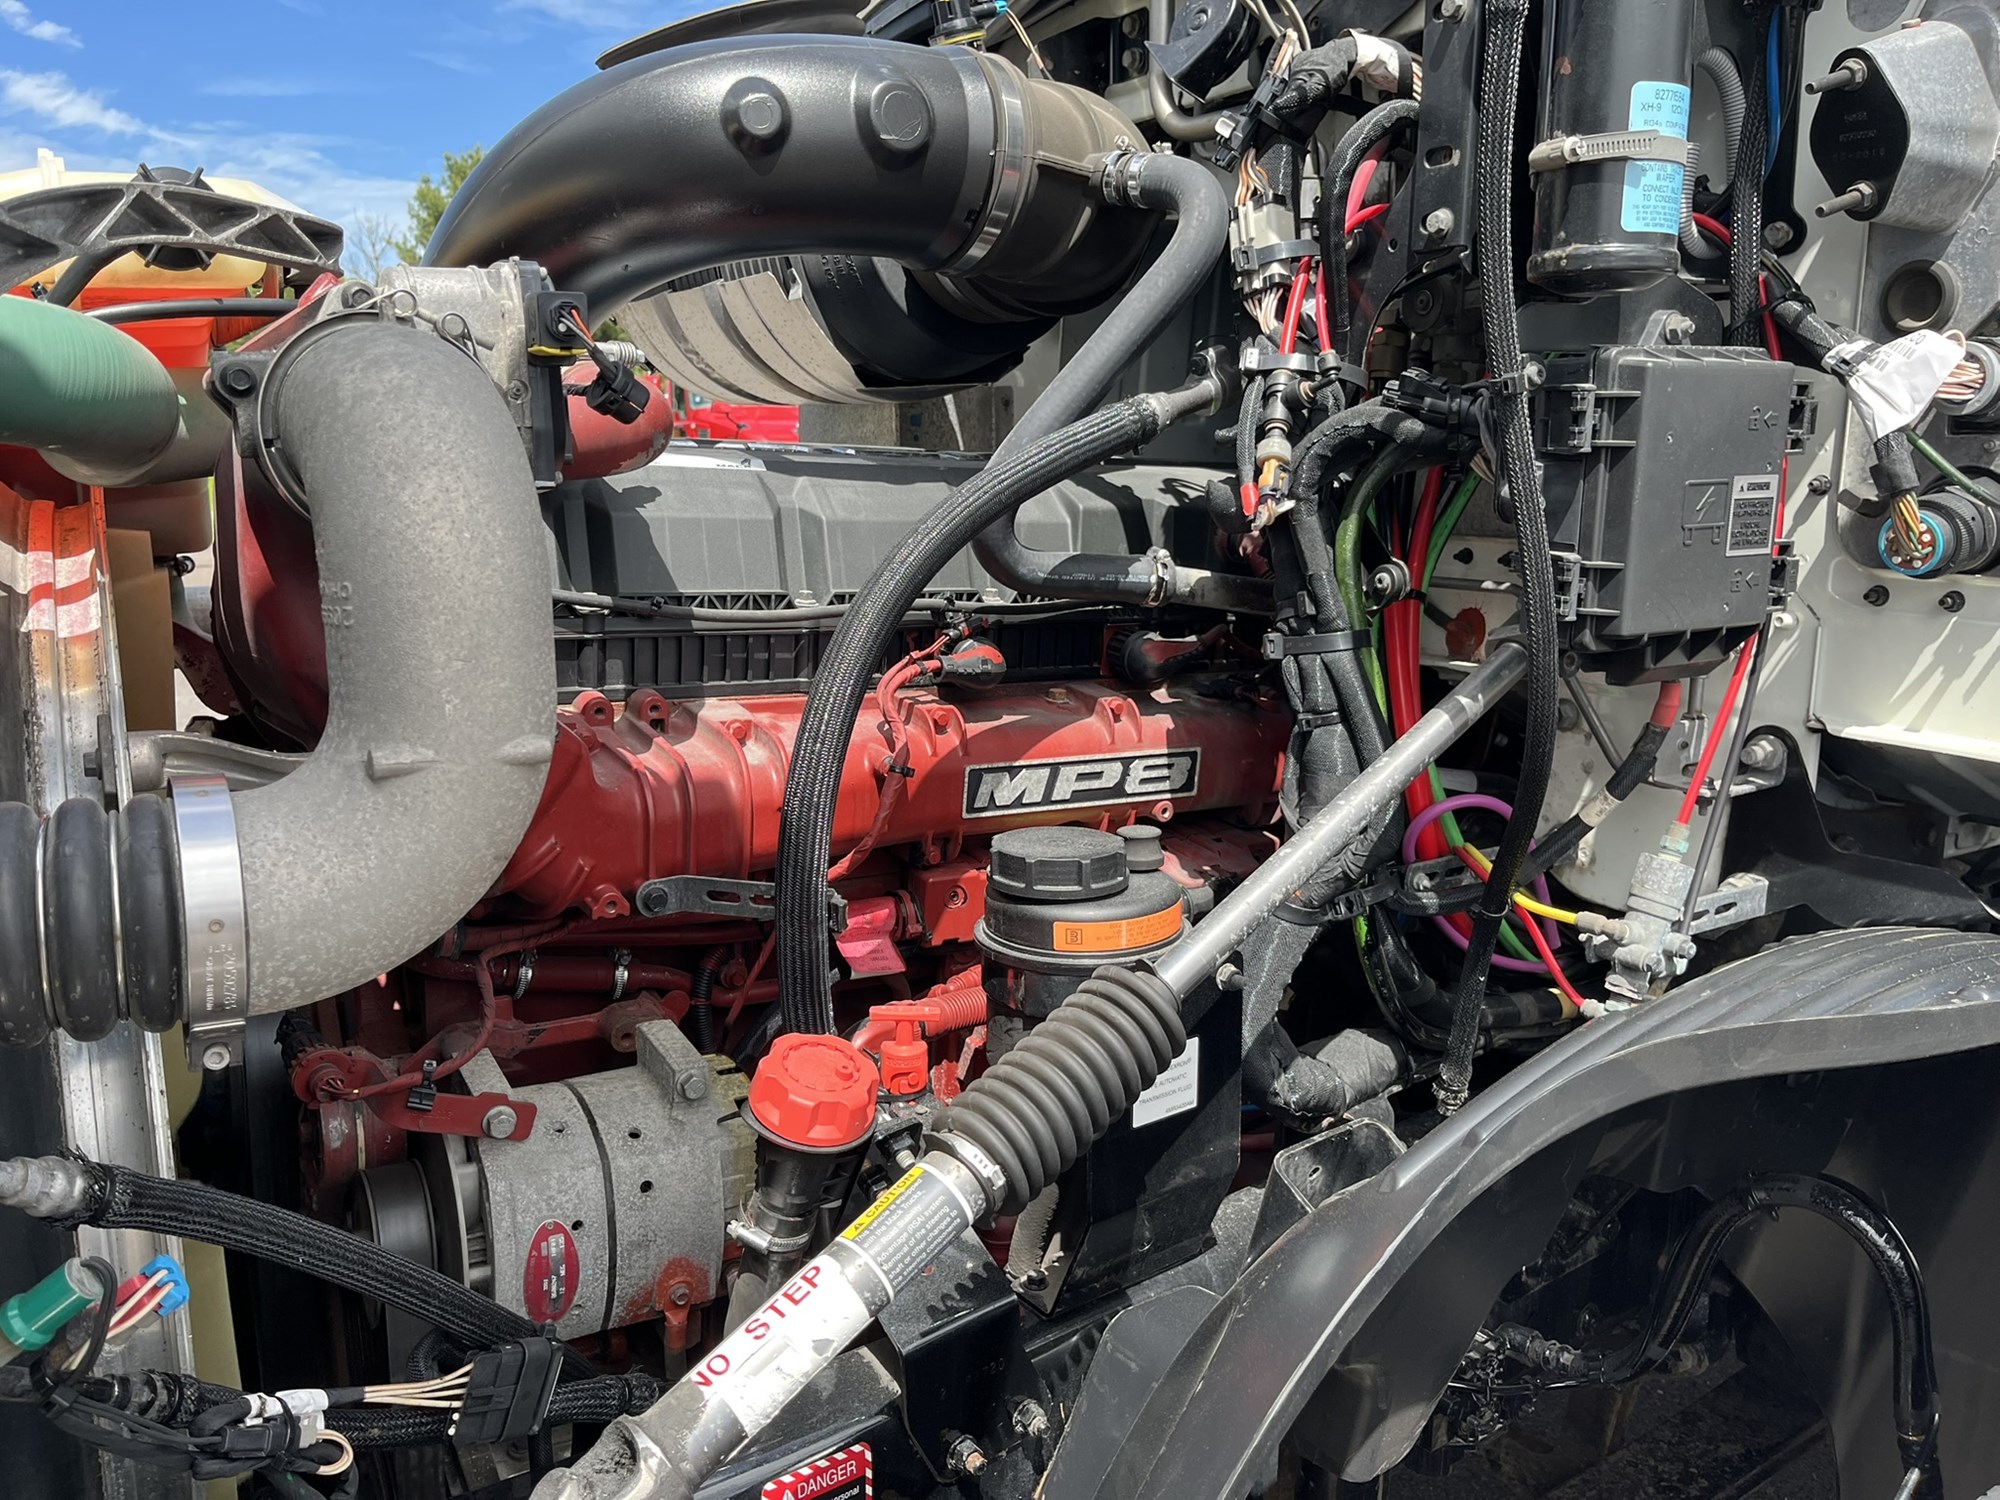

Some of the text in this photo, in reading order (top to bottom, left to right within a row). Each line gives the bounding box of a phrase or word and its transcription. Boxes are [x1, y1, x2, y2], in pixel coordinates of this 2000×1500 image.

[1640, 102, 1662, 112] XH-9
[1642, 184, 1669, 194] CONNECT
[1642, 194, 1651, 202] TO
[974, 756, 1192, 808] MP8
[1139, 1083, 1193, 1106] TRANSMISSION FLUID
[856, 1177, 922, 1242] This vehicle is equipped
[865, 1173, 915, 1218] CAUTION
[861, 1233, 877, 1248] with
[874, 1223, 887, 1236] the
[884, 1207, 903, 1226] Mack
[880, 1225, 899, 1244] Road
[896, 1202, 922, 1229] Stability
[881, 1204, 950, 1272] Removal of the steering
[887, 1208, 958, 1279] shaft or other changes to
[875, 1230, 910, 1265] Advantage
[892, 1216, 962, 1286] the steering components
[744, 1265, 821, 1341] STEP
[797, 1460, 857, 1498] DANGER
